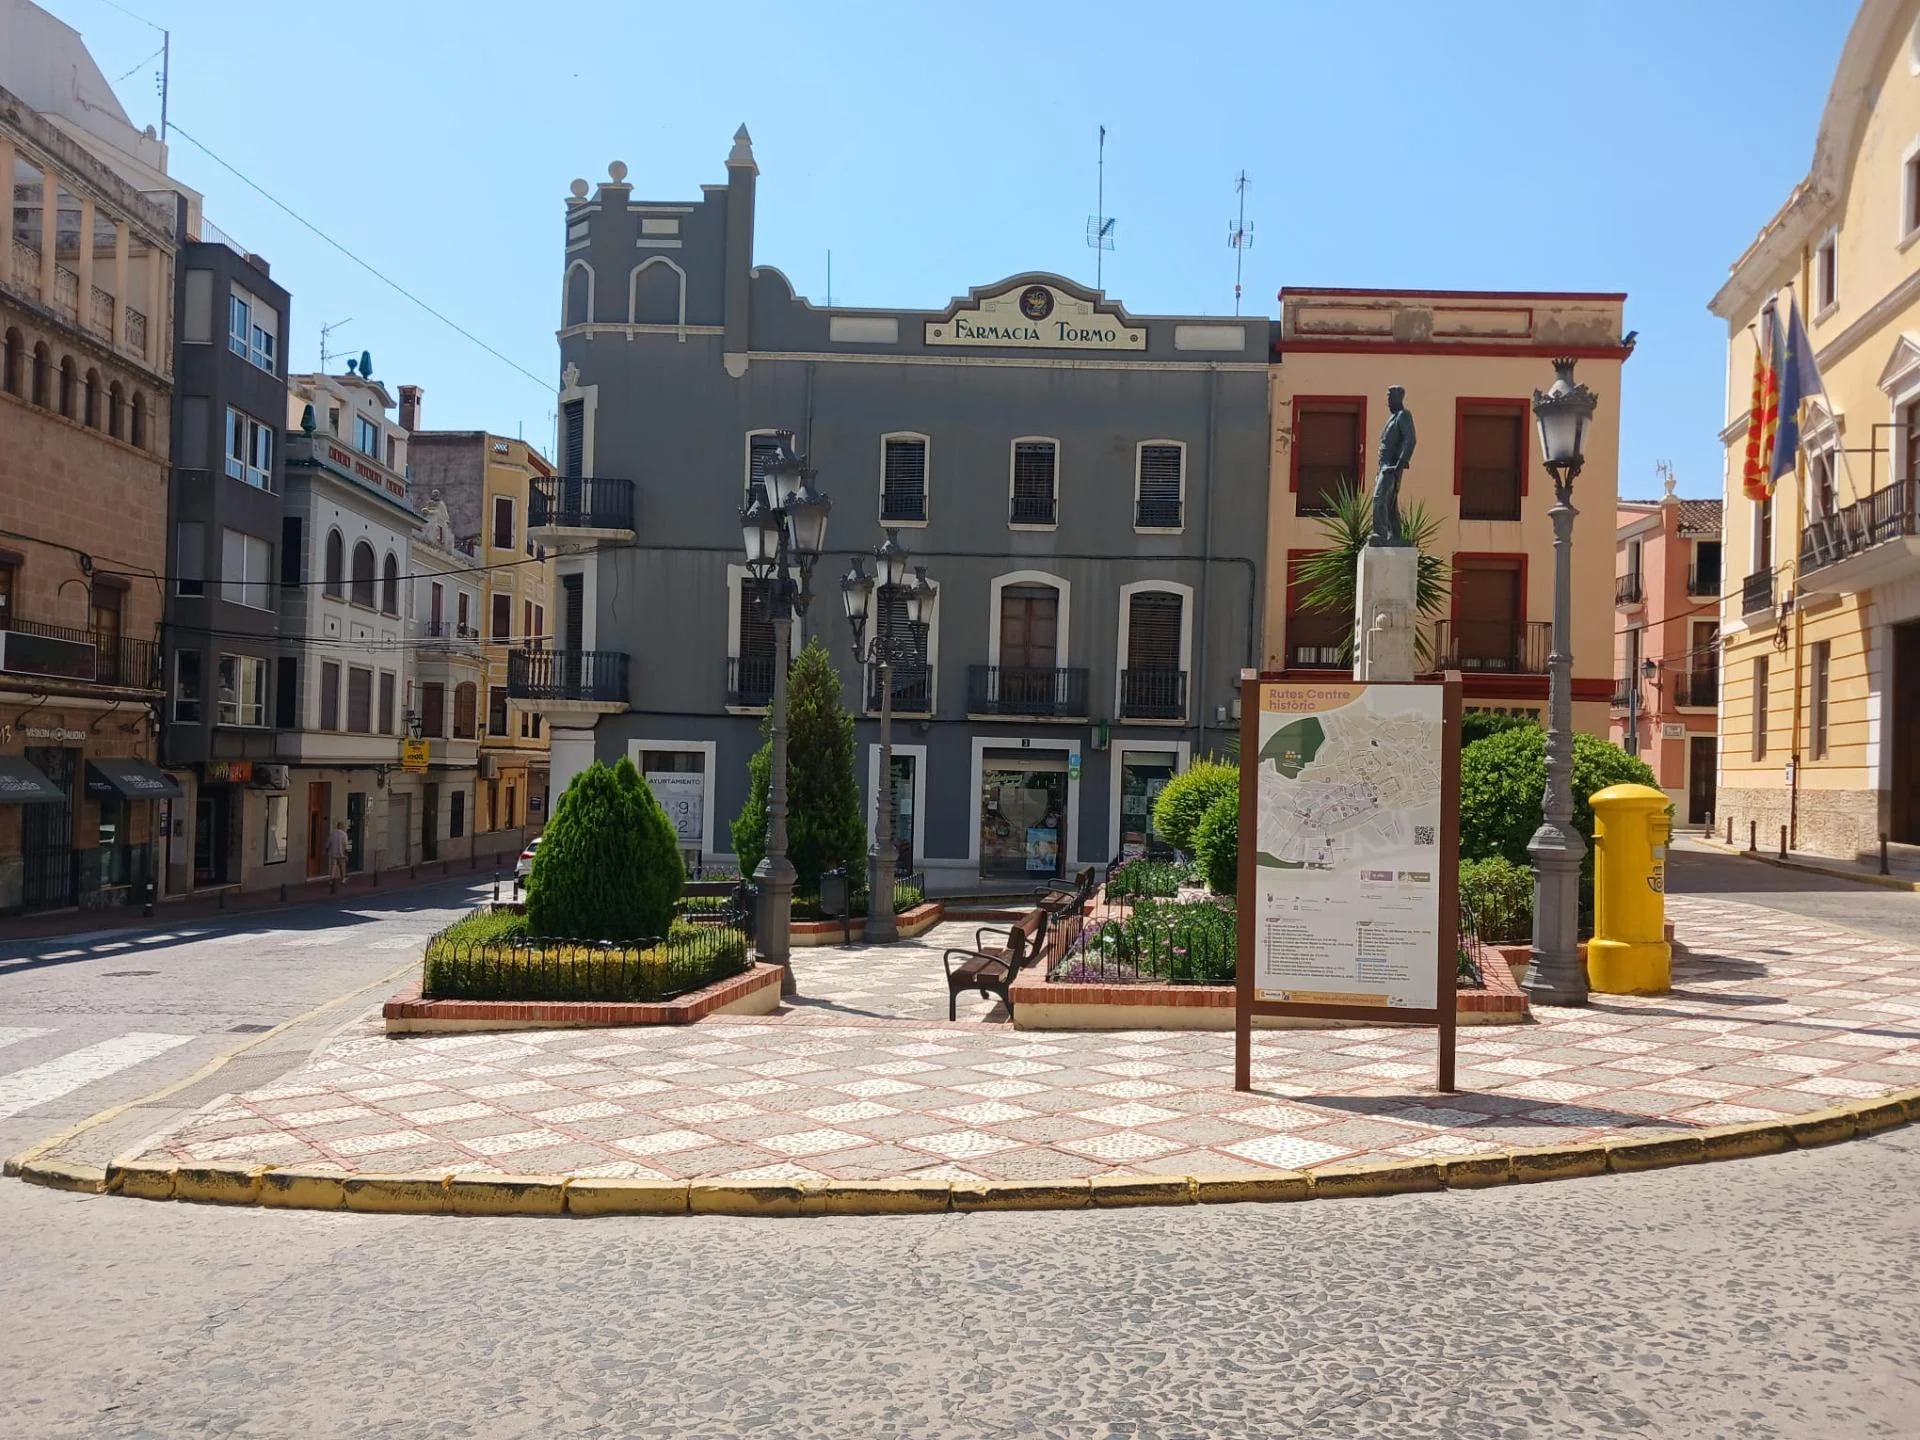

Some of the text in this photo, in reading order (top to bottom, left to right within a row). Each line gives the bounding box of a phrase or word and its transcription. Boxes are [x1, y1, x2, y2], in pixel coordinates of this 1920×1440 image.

[955, 318, 1116, 342] FARMACIA TORMO
[1269, 689, 1350, 699] Rutes Centre
